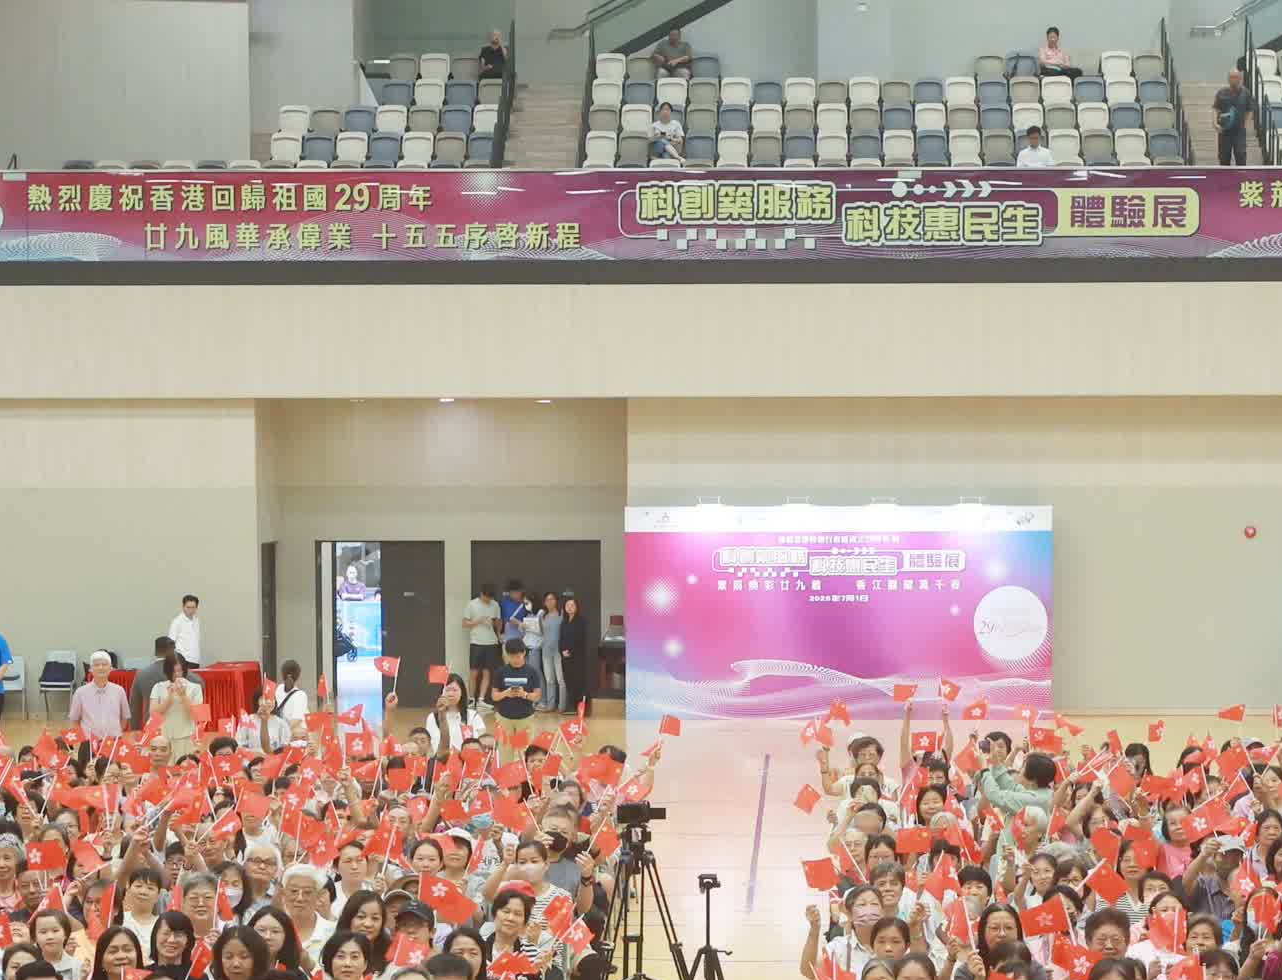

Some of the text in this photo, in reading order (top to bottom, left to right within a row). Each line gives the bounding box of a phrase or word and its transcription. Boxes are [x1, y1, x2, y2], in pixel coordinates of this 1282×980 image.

[26, 183, 434, 212] 熱烈慶祝香港回歸祖國29周年
[638, 183, 836, 221] 科創築服務
[1070, 194, 1189, 230] 體驗展
[144, 222, 352, 252] 廿九風華承偉業
[845, 204, 1042, 245] 科技惠民生
